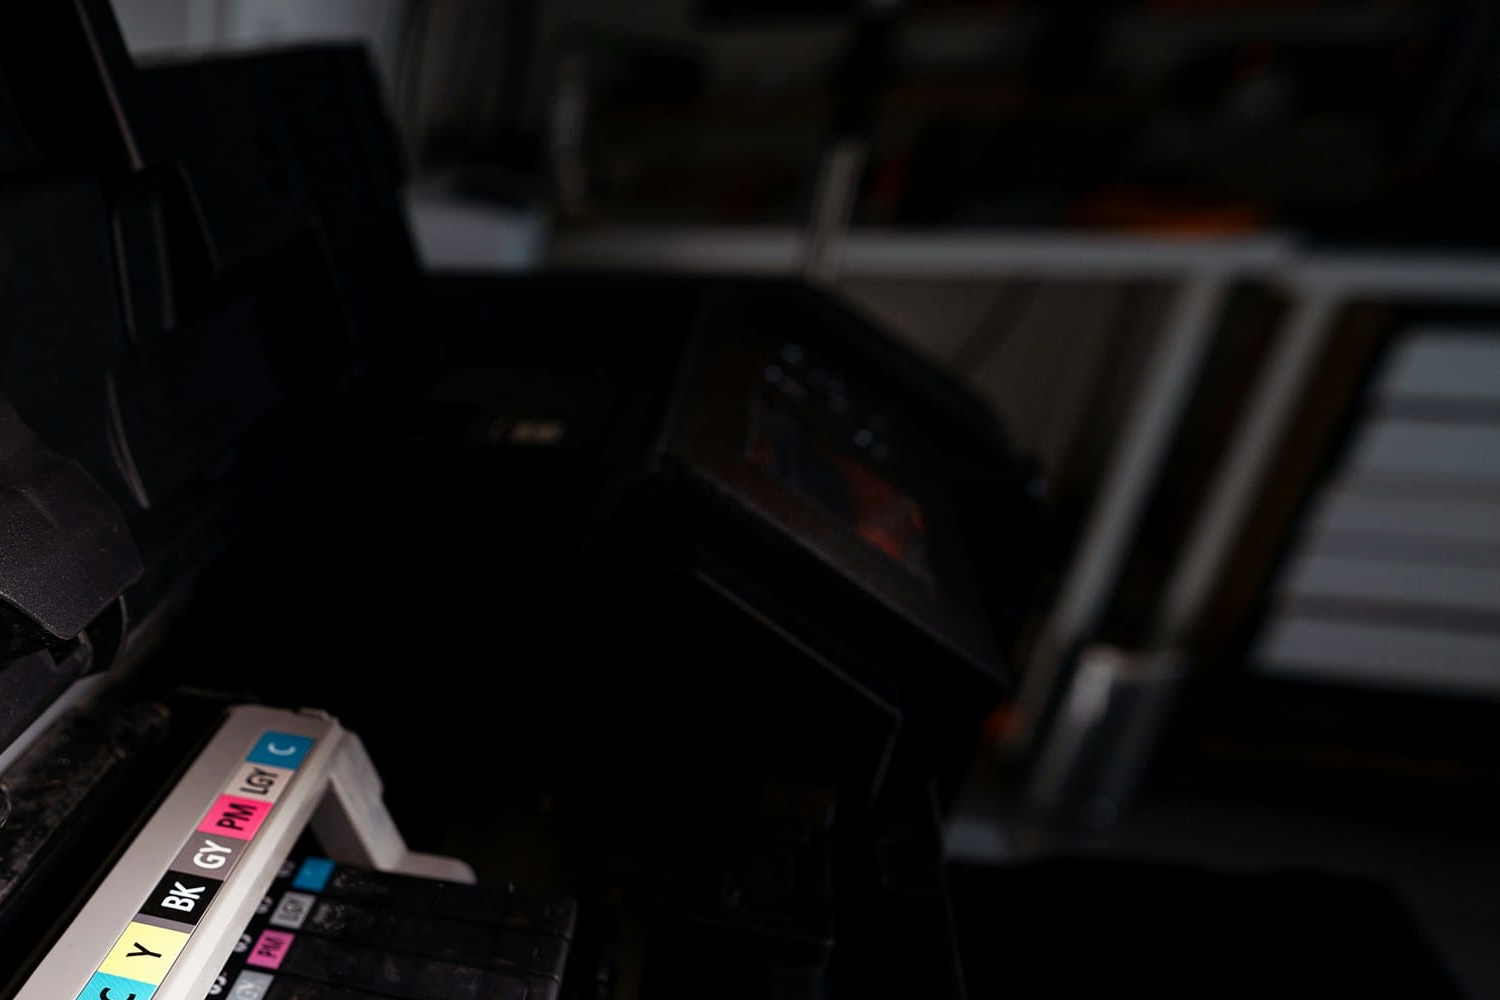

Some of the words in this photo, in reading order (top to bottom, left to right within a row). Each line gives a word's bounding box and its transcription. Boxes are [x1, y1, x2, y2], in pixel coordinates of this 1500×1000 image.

[267, 741, 296, 756] C
[239, 766, 278, 796] LGY
[217, 803, 257, 831] PM
[193, 839, 233, 870] GY
[161, 881, 206, 913] BK
[126, 941, 162, 960] Y
